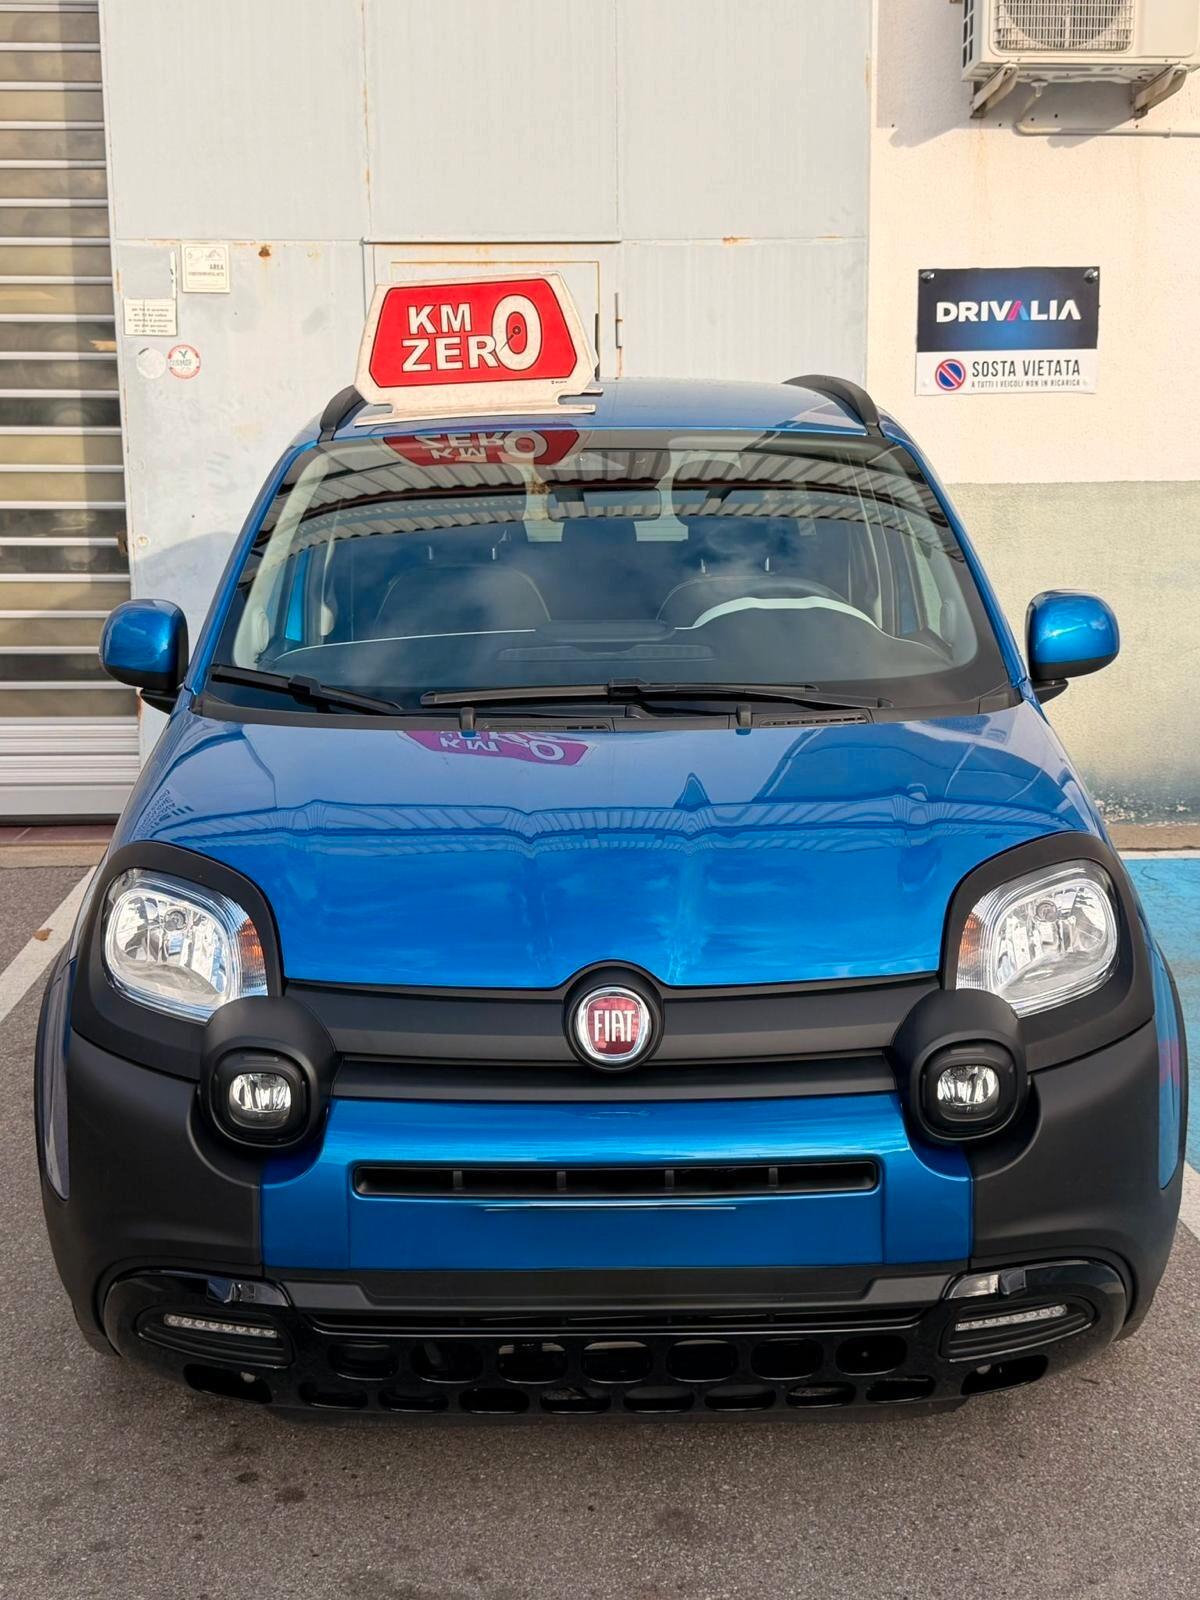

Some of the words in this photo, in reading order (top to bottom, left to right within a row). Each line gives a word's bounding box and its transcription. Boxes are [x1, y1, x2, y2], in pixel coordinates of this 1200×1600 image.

[406, 302, 472, 335] KM
[936, 299, 1081, 323] DRIVALIA
[972, 360, 1016, 377] SOSTA
[1022, 359, 1080, 376] VIETATA
[977, 380, 994, 388] TUTTI
[1000, 380, 1024, 388] VEICOLI
[1026, 379, 1039, 387] NON
[1041, 379, 1048, 387] IN
[1050, 379, 1080, 387] RICARICA
[593, 1010, 636, 1042] FIAT
